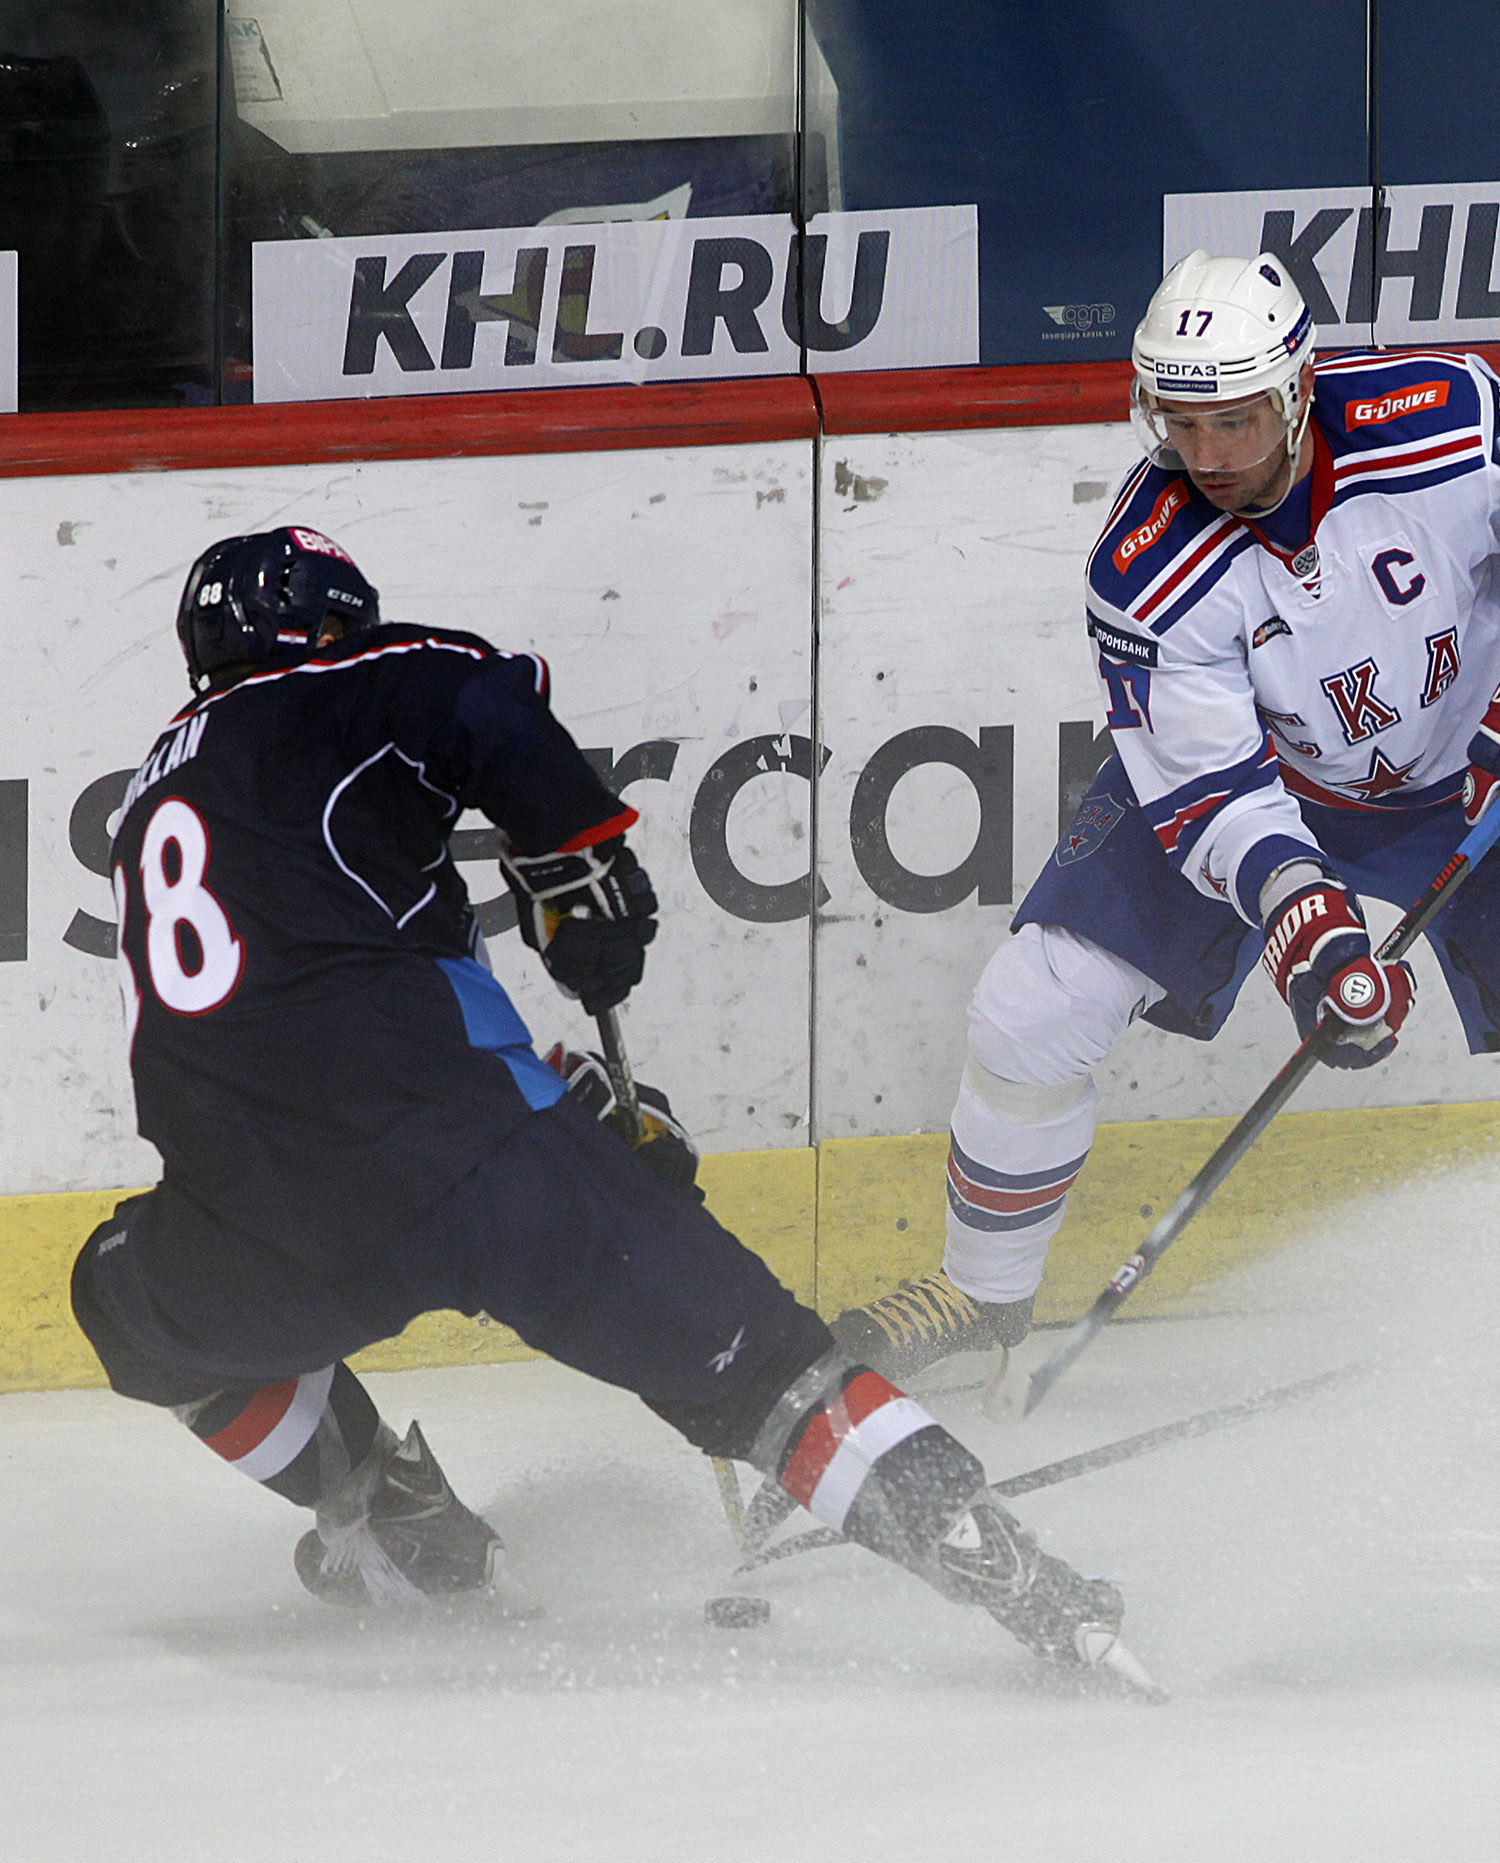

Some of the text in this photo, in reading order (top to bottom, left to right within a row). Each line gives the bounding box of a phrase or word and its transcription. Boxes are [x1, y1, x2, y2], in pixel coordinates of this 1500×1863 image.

[342, 230, 891, 376] KHL.RU
[1176, 309, 1213, 337] 17
[1155, 362, 1217, 377] СОГАЗ
[1371, 548, 1426, 606] C
[199, 582, 223, 606] 88
[1094, 626, 1150, 659] ПРОМБАНК
